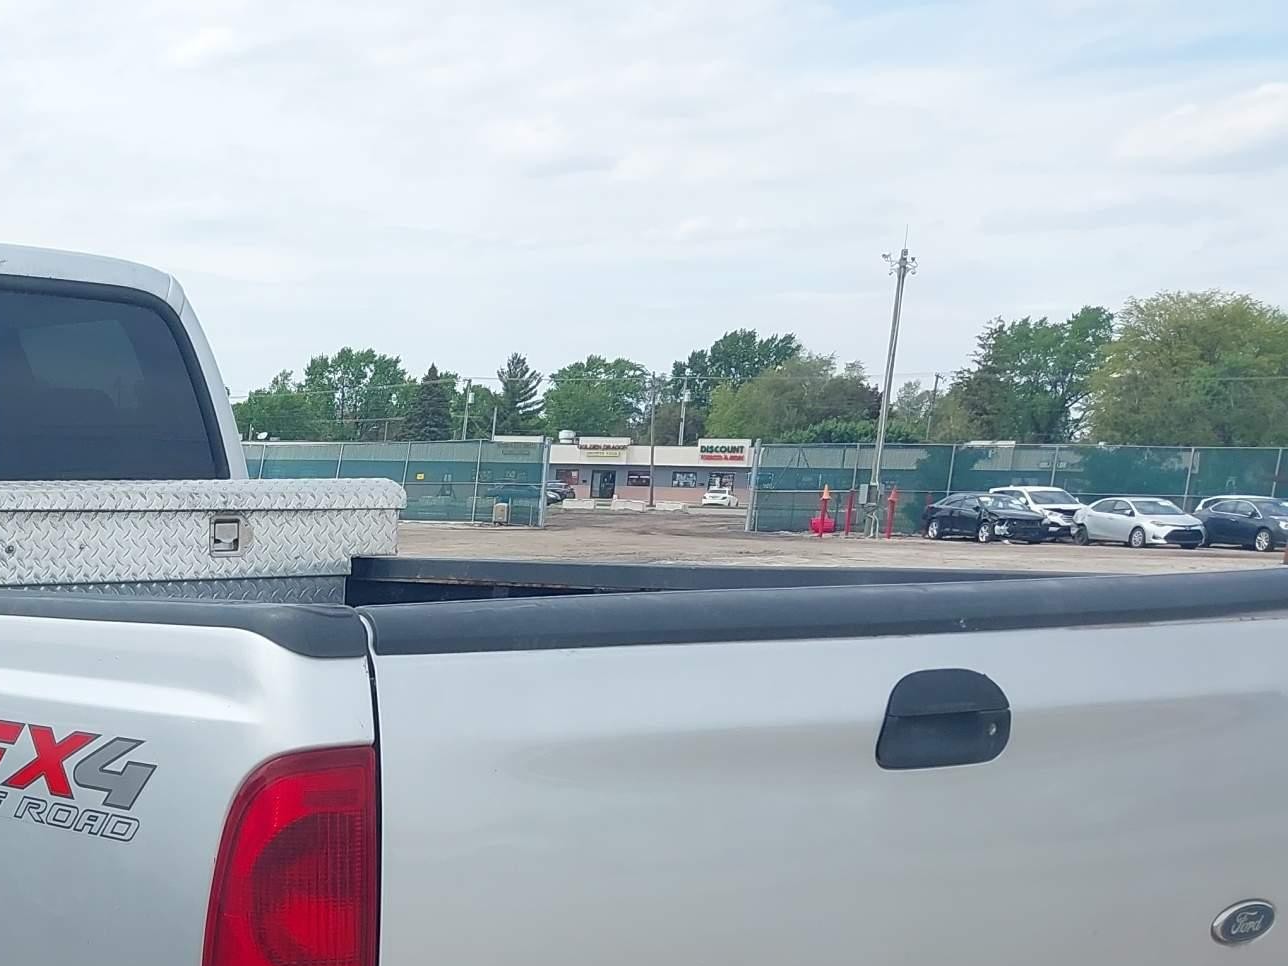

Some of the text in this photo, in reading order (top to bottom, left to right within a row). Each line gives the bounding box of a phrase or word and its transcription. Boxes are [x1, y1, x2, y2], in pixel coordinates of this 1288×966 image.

[700, 445, 745, 454] DISCOUNT
[14, 795, 141, 842] ROAD
[1231, 911, 1265, 935] Ford
